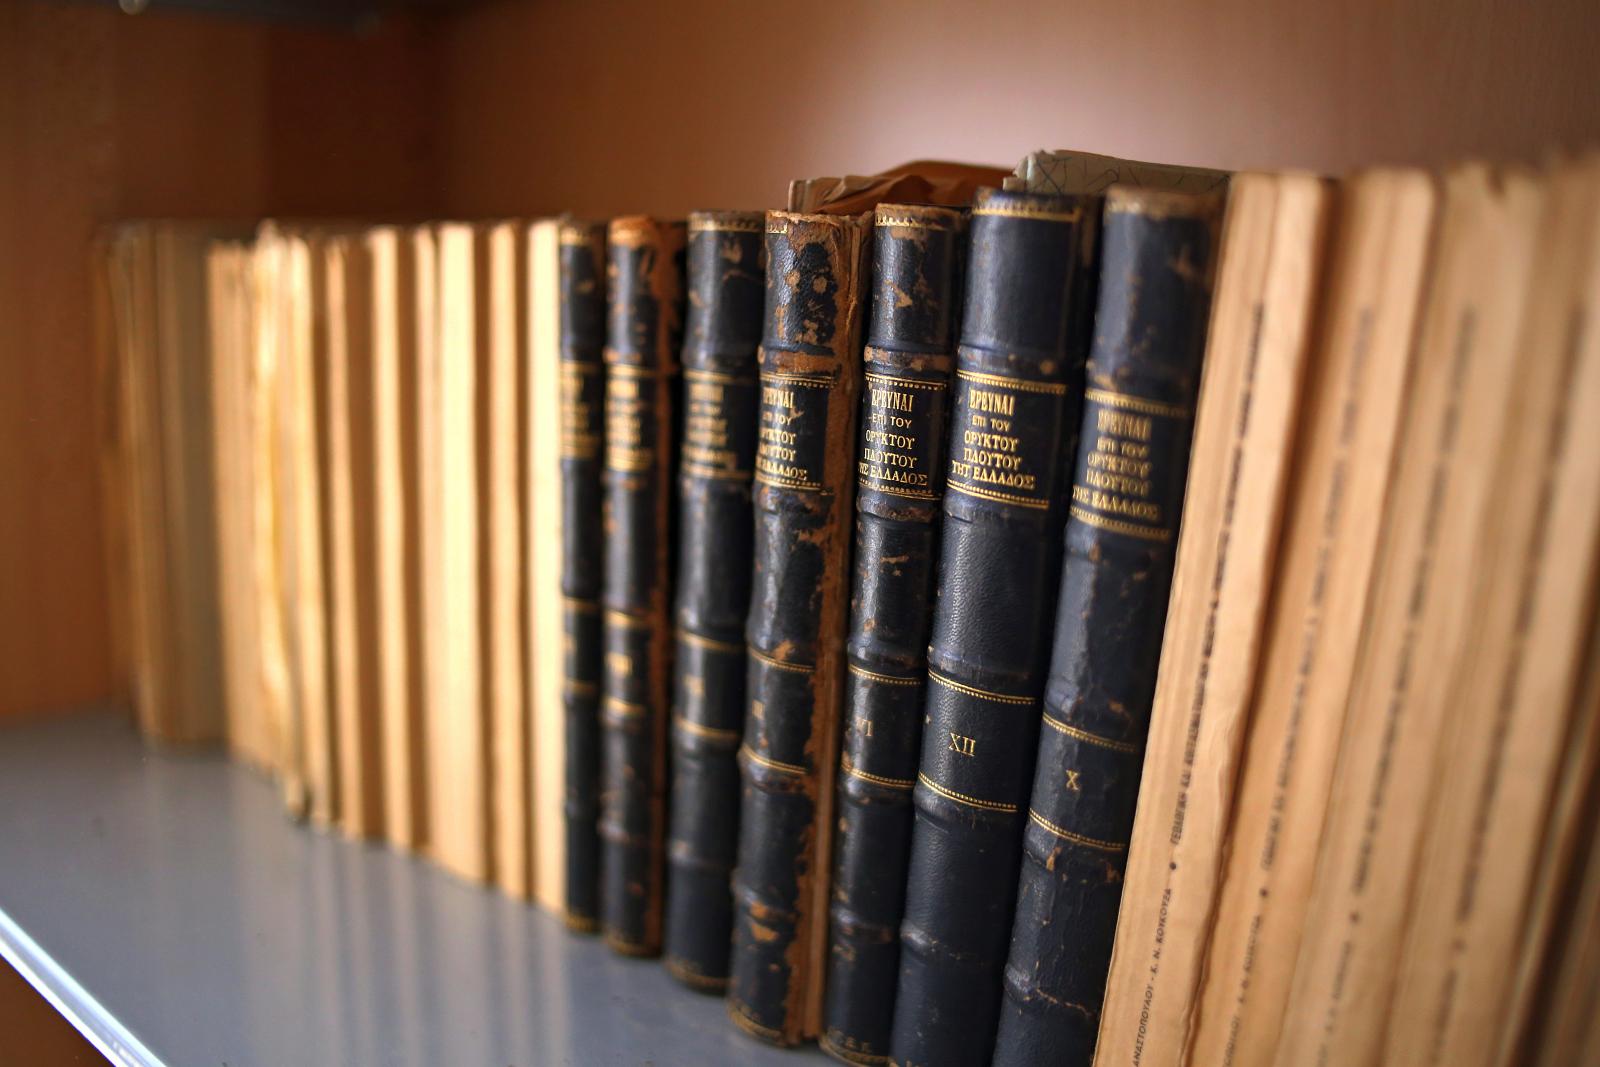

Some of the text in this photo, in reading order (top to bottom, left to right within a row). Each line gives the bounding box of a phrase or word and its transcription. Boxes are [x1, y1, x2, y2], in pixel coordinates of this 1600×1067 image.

[871, 389, 914, 412] ΕΡΕΥΝΑΙ
[969, 388, 1015, 416] ΕΡΕΥΝΑΙ
[890, 415, 912, 430] ΤΟΥ
[991, 417, 1010, 432] ΤΟΥ
[865, 429, 915, 450] ΟΡΥΚΤΟΥ
[964, 430, 1018, 453] ΟΡΥΚΤΟΥ
[864, 447, 918, 469] ΠΛΟΥΤΟΥ
[963, 448, 1022, 471] ΠΛΟΥΤΟΥ
[870, 465, 928, 487] ΕΛΛΑΔΟΣ
[972, 466, 1036, 490] ΕΛΛΑΔΟΣ
[948, 732, 976, 757] XII
[1065, 769, 1080, 791] X
